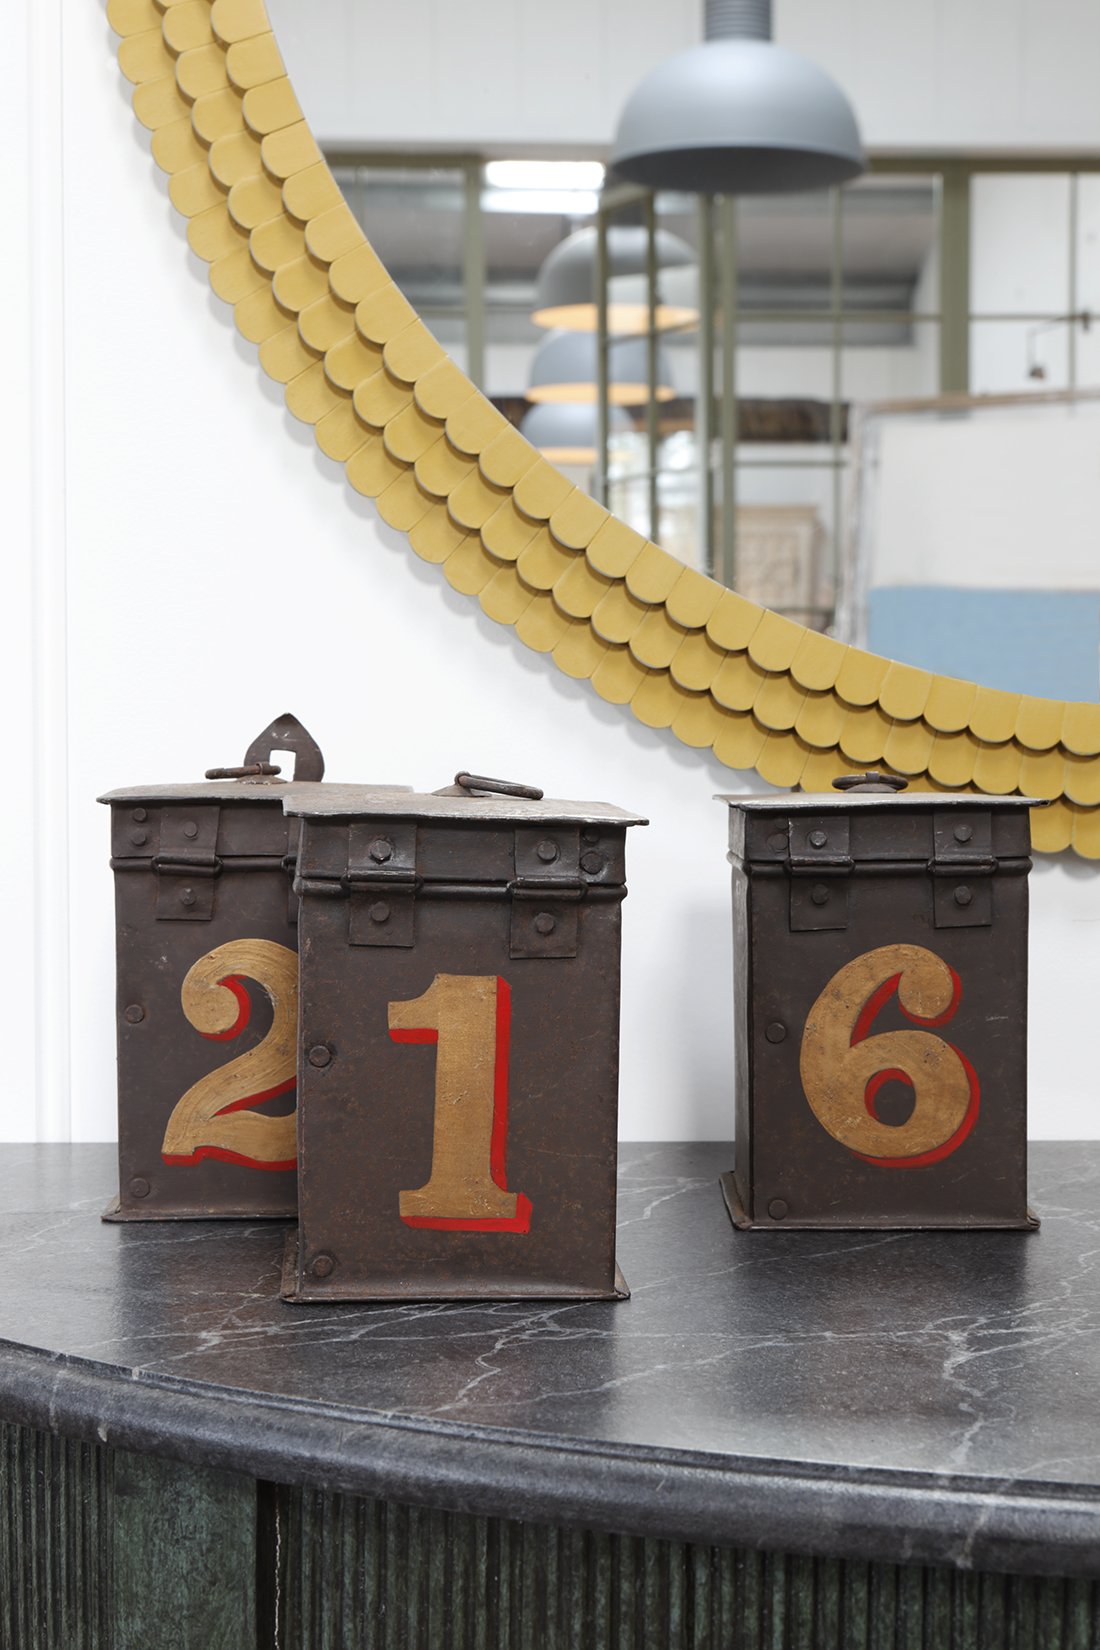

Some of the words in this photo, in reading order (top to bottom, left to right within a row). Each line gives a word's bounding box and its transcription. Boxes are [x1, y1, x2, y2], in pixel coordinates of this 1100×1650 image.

[161, 938, 298, 1171] 2
[388, 973, 532, 1233] 1
[800, 943, 980, 1168] 6
